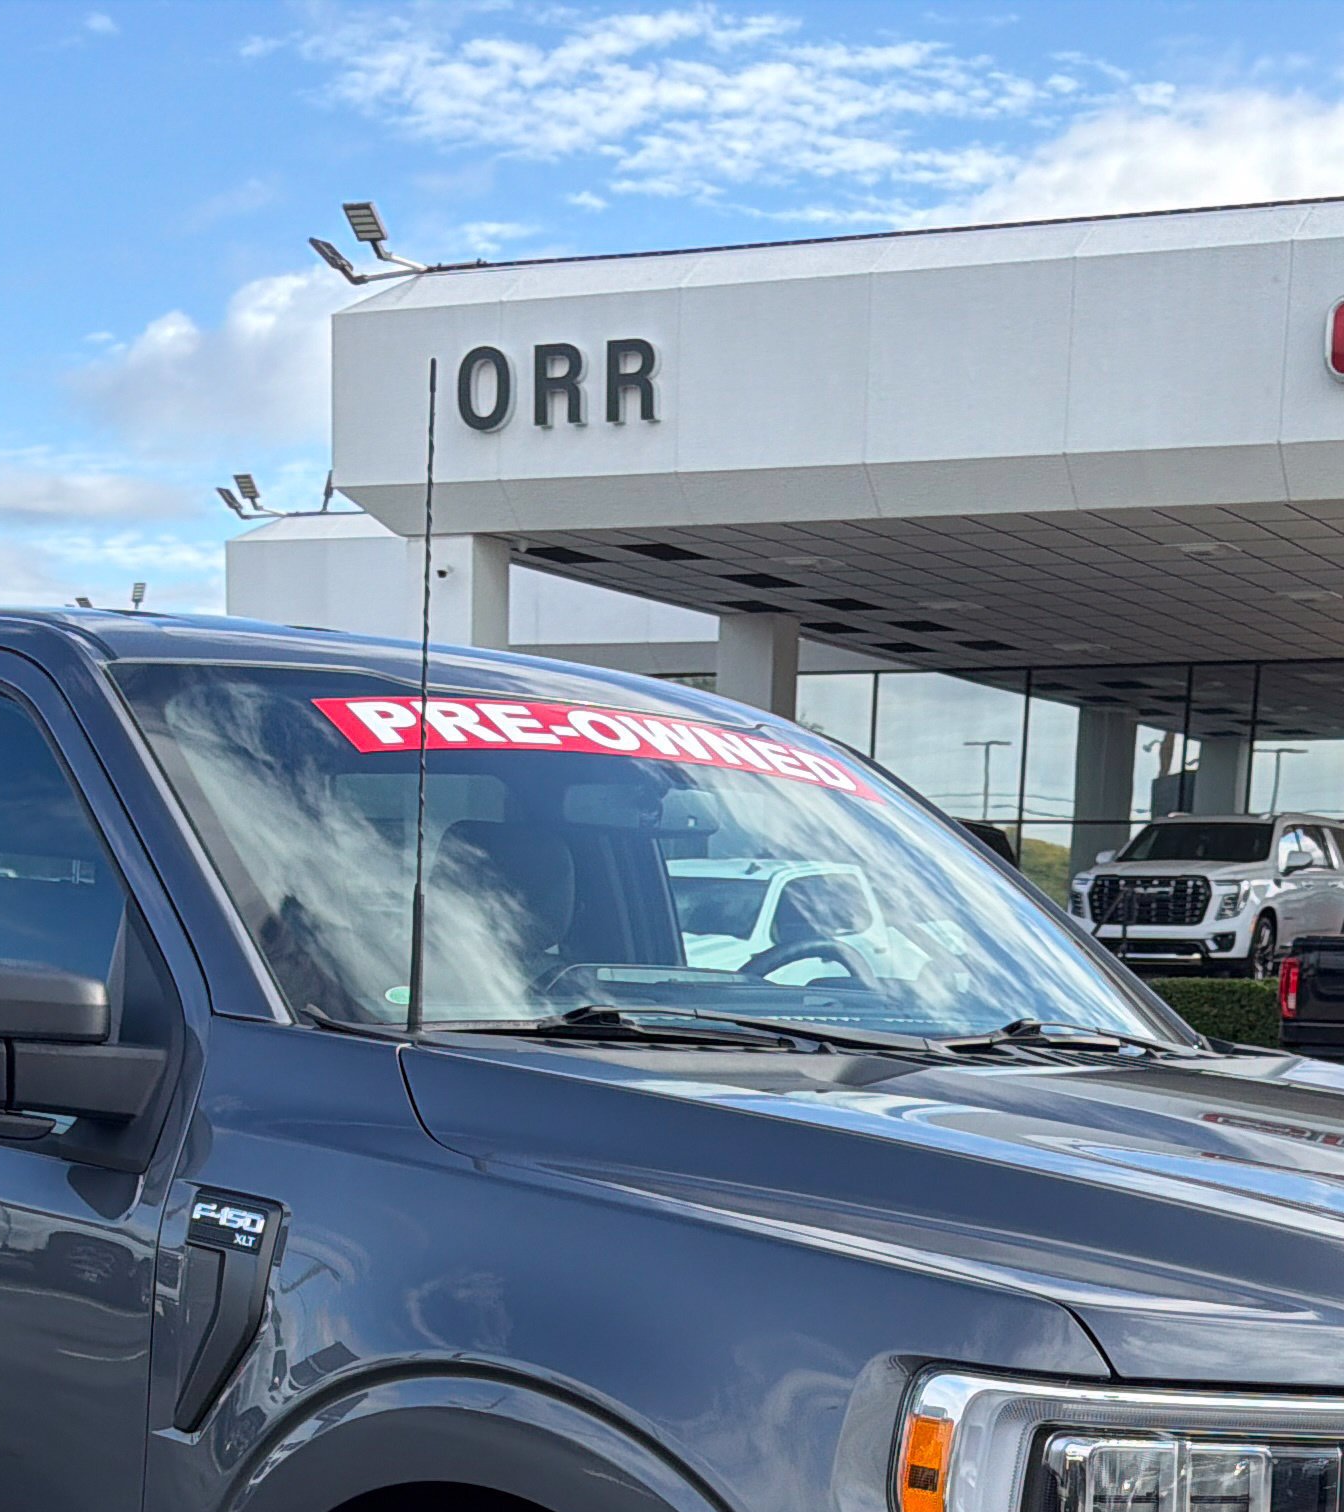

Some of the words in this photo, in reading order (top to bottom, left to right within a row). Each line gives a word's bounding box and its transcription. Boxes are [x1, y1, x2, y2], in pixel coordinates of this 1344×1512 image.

[457, 338, 660, 431] ORR
[345, 700, 858, 792] PRE-OWNED
[192, 1202, 266, 1234] F-150
[232, 1232, 257, 1248] XLT
